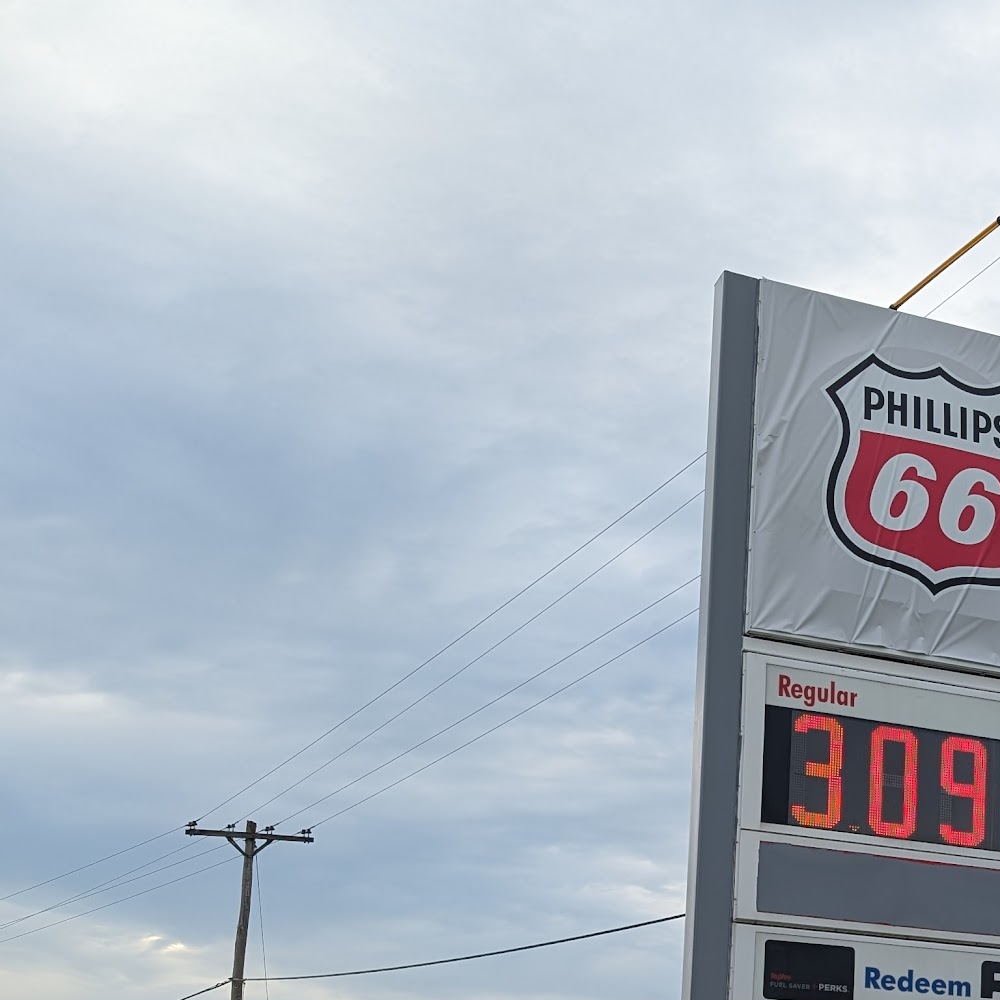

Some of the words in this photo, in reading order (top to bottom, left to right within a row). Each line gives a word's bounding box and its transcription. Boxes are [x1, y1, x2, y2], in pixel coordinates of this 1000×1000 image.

[778, 674, 858, 708] Regular
[769, 981, 787, 989] FUEL
[788, 982, 811, 990] SAVER
[864, 966, 972, 998] Redeem
